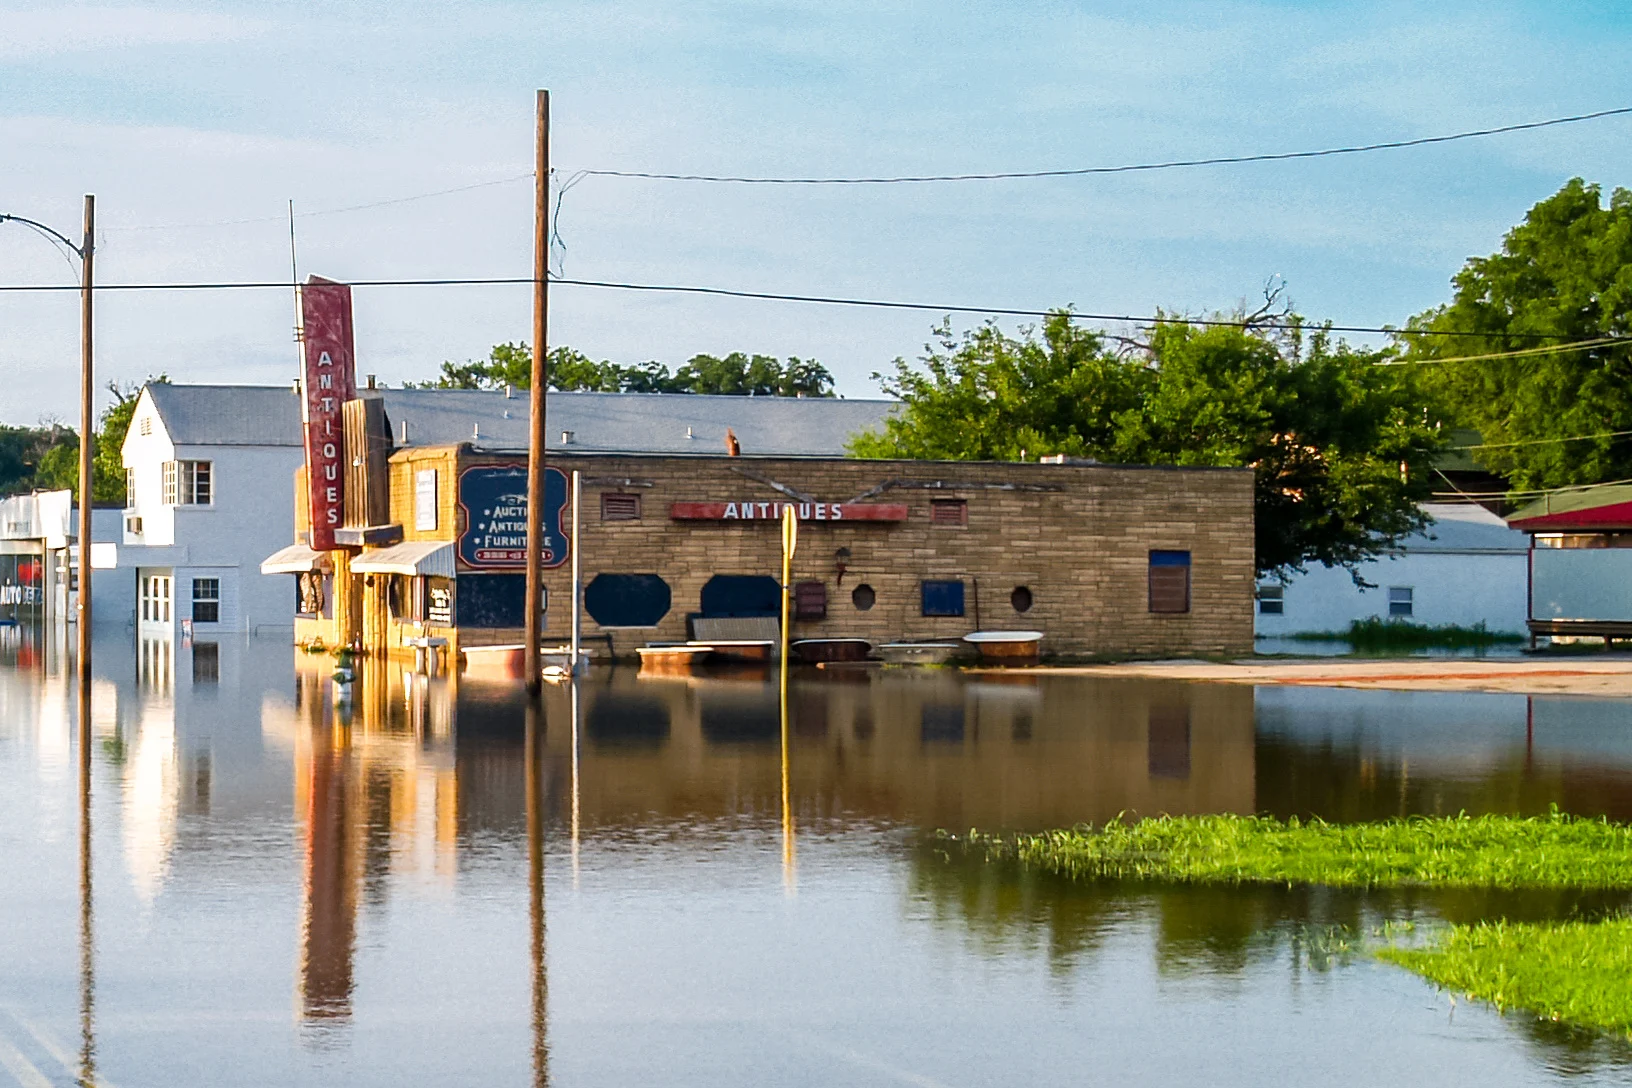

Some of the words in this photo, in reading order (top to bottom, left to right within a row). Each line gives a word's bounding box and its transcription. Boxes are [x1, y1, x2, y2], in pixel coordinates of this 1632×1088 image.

[318, 351, 338, 524] ANTIQUES
[492, 505, 528, 519] AUCTI
[723, 502, 843, 520] ANTIUES
[488, 520, 547, 534] ANTIQS
[484, 535, 552, 548] FURNITE
